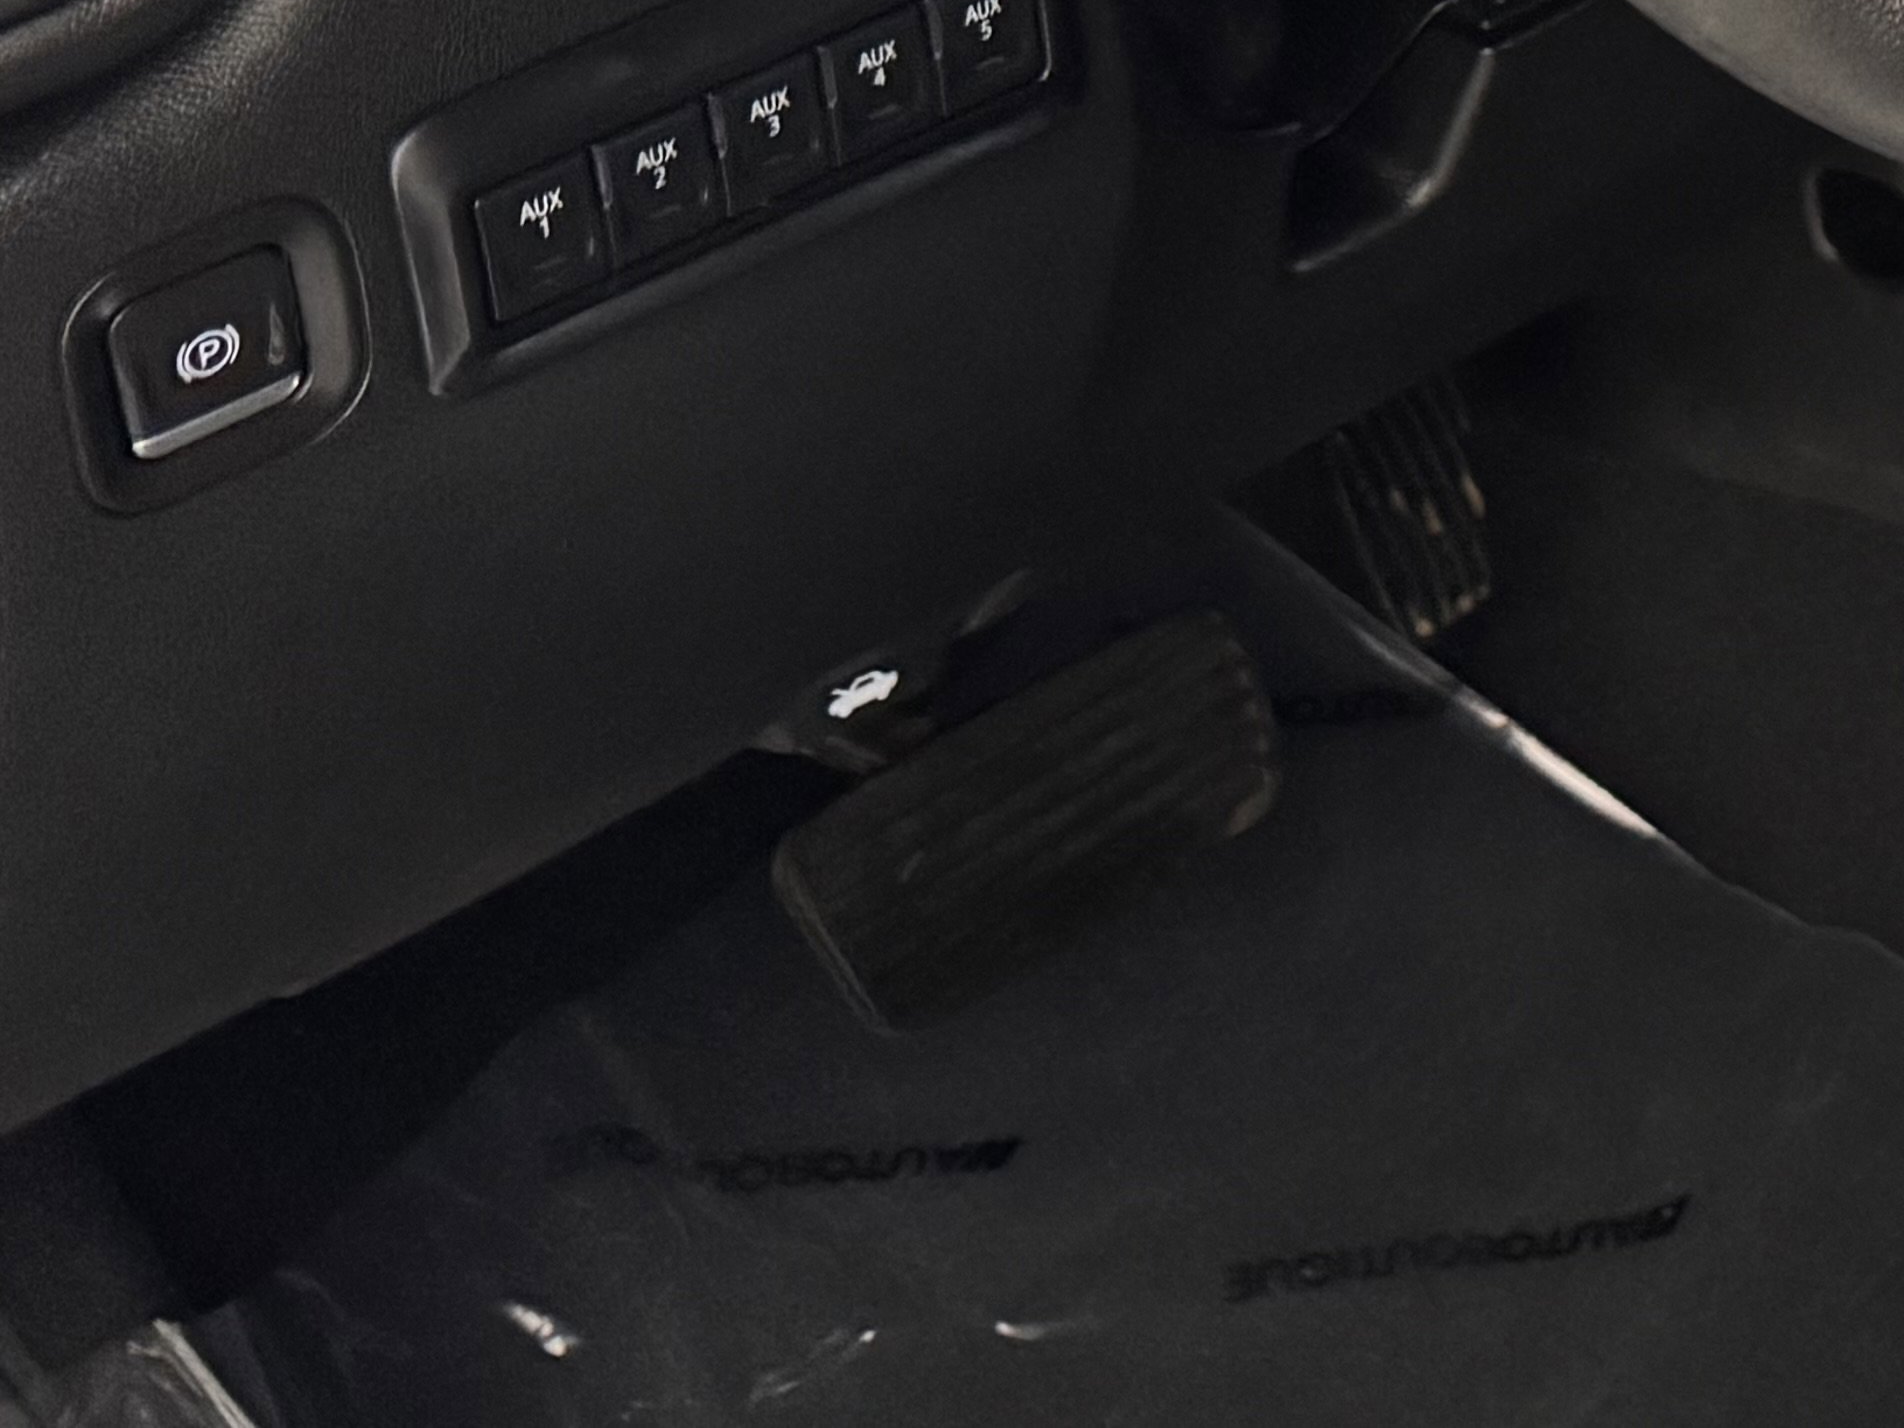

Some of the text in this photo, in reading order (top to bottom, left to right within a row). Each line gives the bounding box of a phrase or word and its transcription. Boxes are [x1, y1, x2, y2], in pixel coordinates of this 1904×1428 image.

[980, 19, 993, 41] 5
[858, 40, 897, 74] AUX
[873, 66, 886, 87] 4
[750, 85, 790, 123] AUX
[768, 114, 781, 137] 3
[635, 138, 677, 177] AUX
[653, 166, 667, 189] 2
[519, 187, 563, 226] AUX
[540, 214, 551, 239] 1
